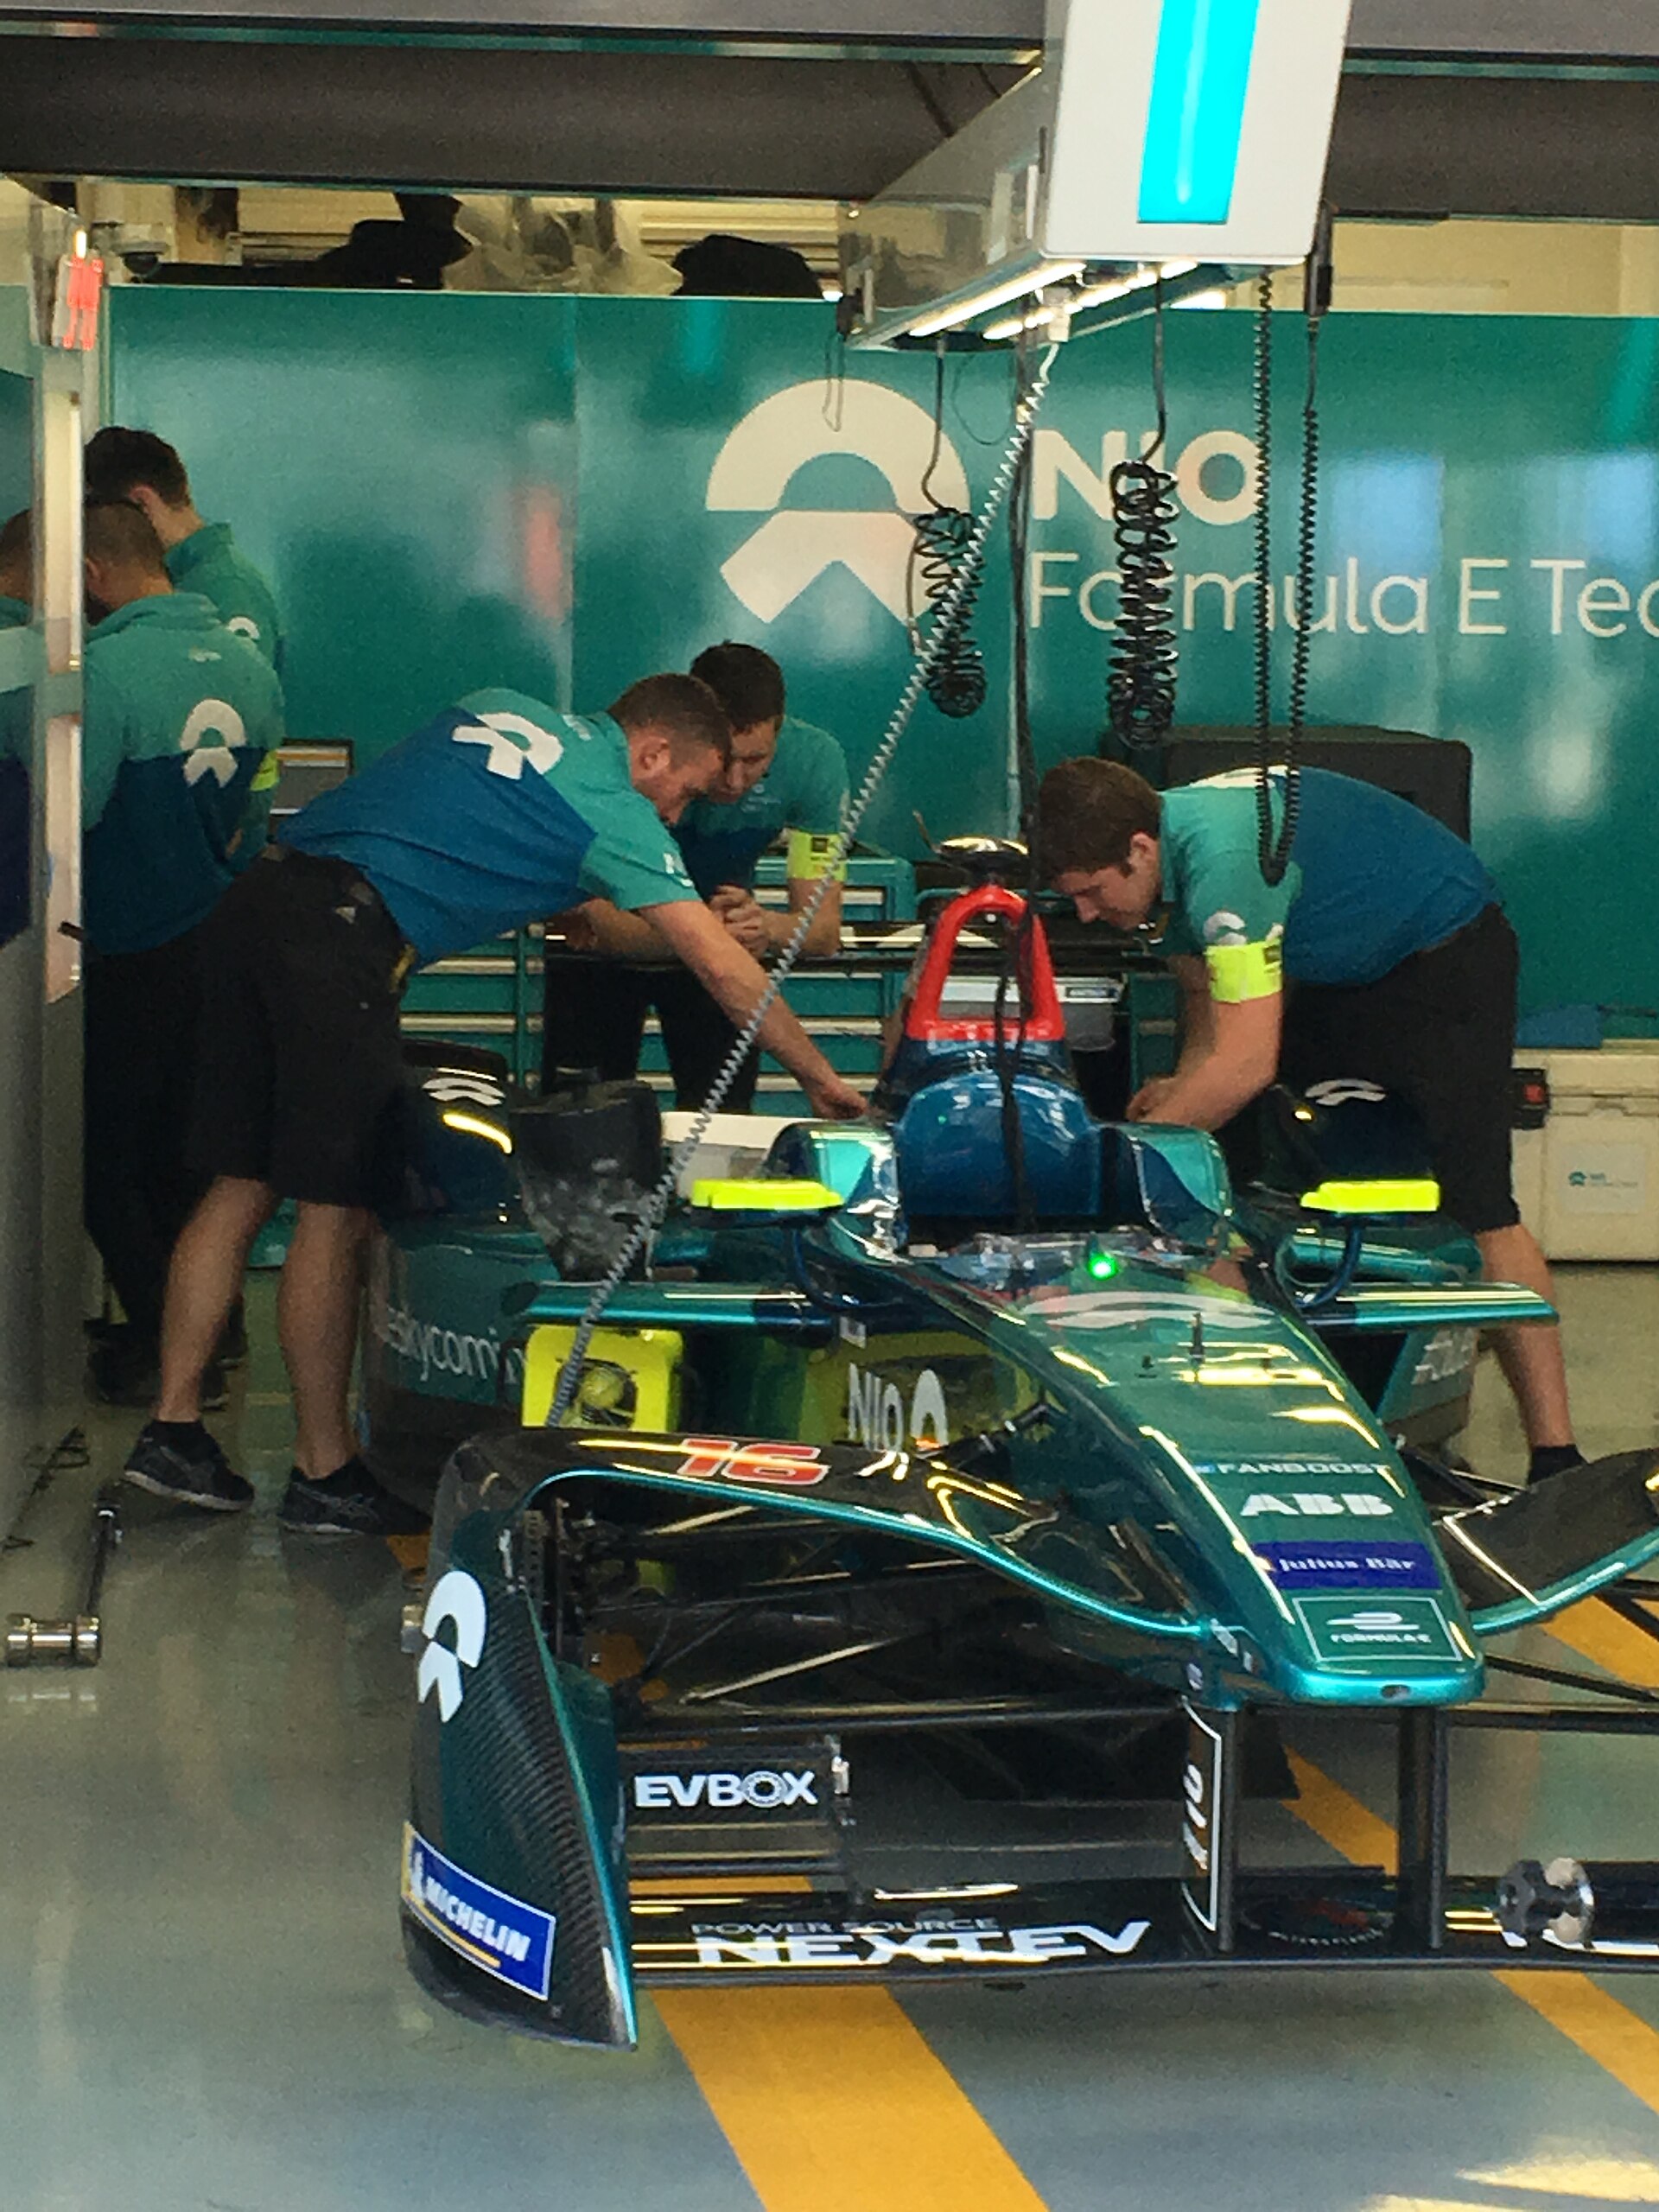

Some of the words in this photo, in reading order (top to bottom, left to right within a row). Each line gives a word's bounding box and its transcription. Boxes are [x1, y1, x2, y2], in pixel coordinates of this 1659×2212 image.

[1030, 551, 1429, 635] Fomula
[1459, 557, 1510, 635] E
[849, 1362, 904, 1452] NIO
[676, 1438, 832, 1485] 16
[1217, 1462, 1391, 1474] FANBOOST
[1239, 1493, 1395, 1517] ABB
[634, 1770, 819, 1808] EVBOX
[426, 1876, 531, 1962] MICHELIN
[692, 1921, 832, 1936] POWER
[696, 1920, 1151, 1964] NEXTEV
